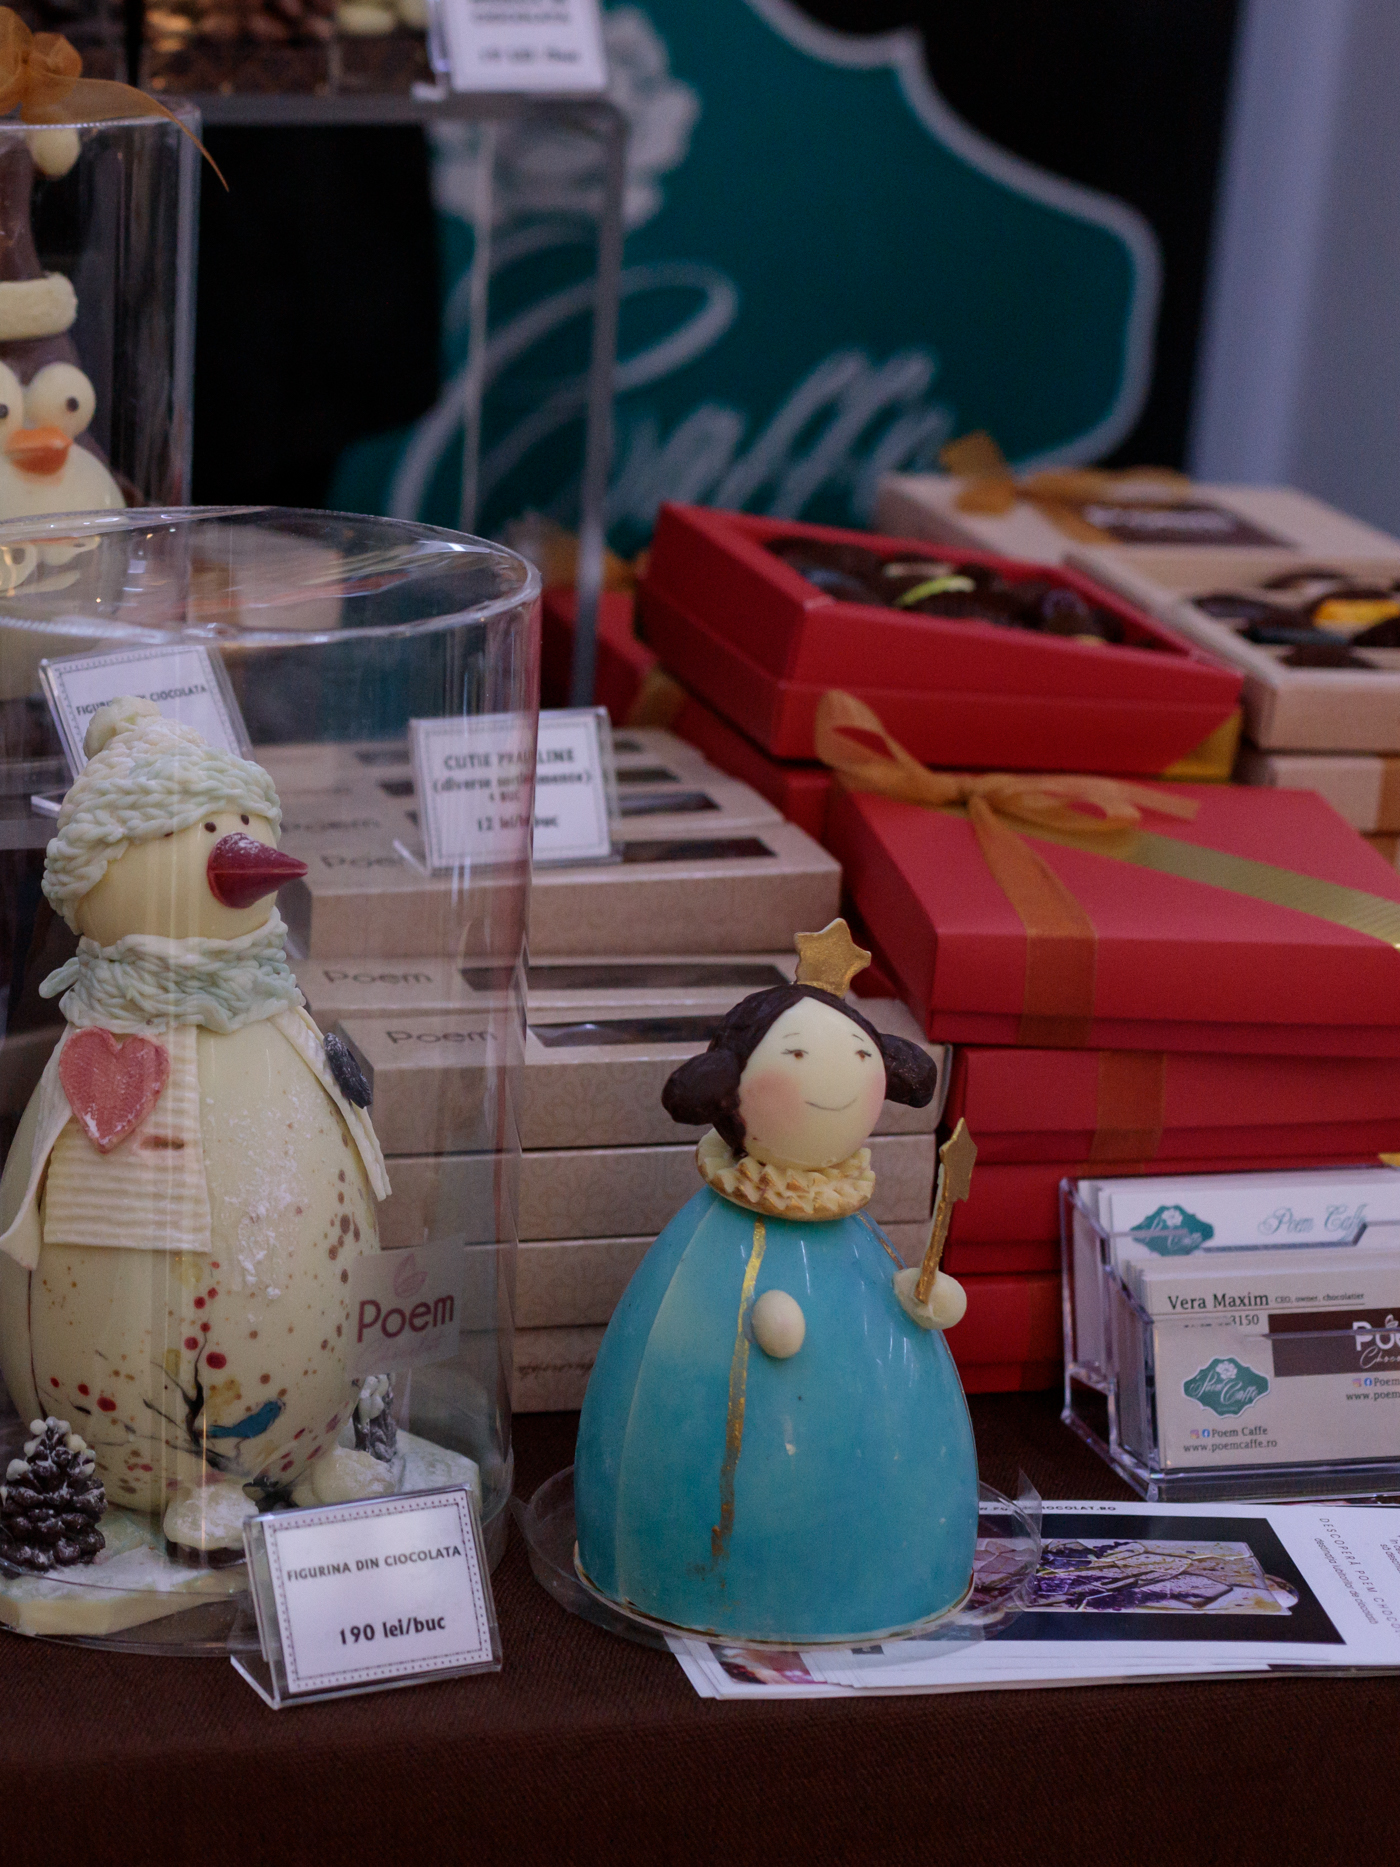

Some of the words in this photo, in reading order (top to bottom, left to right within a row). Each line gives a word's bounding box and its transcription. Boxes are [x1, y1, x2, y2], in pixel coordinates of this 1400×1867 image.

[149, 684, 208, 703] CIOCOLATA
[444, 752, 491, 771] CUTIE
[323, 968, 433, 985] Poem
[385, 1029, 499, 1045] Poem
[1167, 1294, 1207, 1311] Vera
[1213, 1291, 1269, 1309] Maxim
[357, 1294, 455, 1344] Poem
[1211, 1428, 1238, 1438] Poem
[1241, 1426, 1268, 1437] Caffe
[1183, 1438, 1278, 1453] www.poemcaffe.ro
[287, 1561, 351, 1582] FIGURINA
[356, 1557, 380, 1572] DIN
[384, 1545, 462, 1567] CIOCOLATA
[339, 1623, 375, 1645] 190
[382, 1616, 446, 1639] lei/buc
